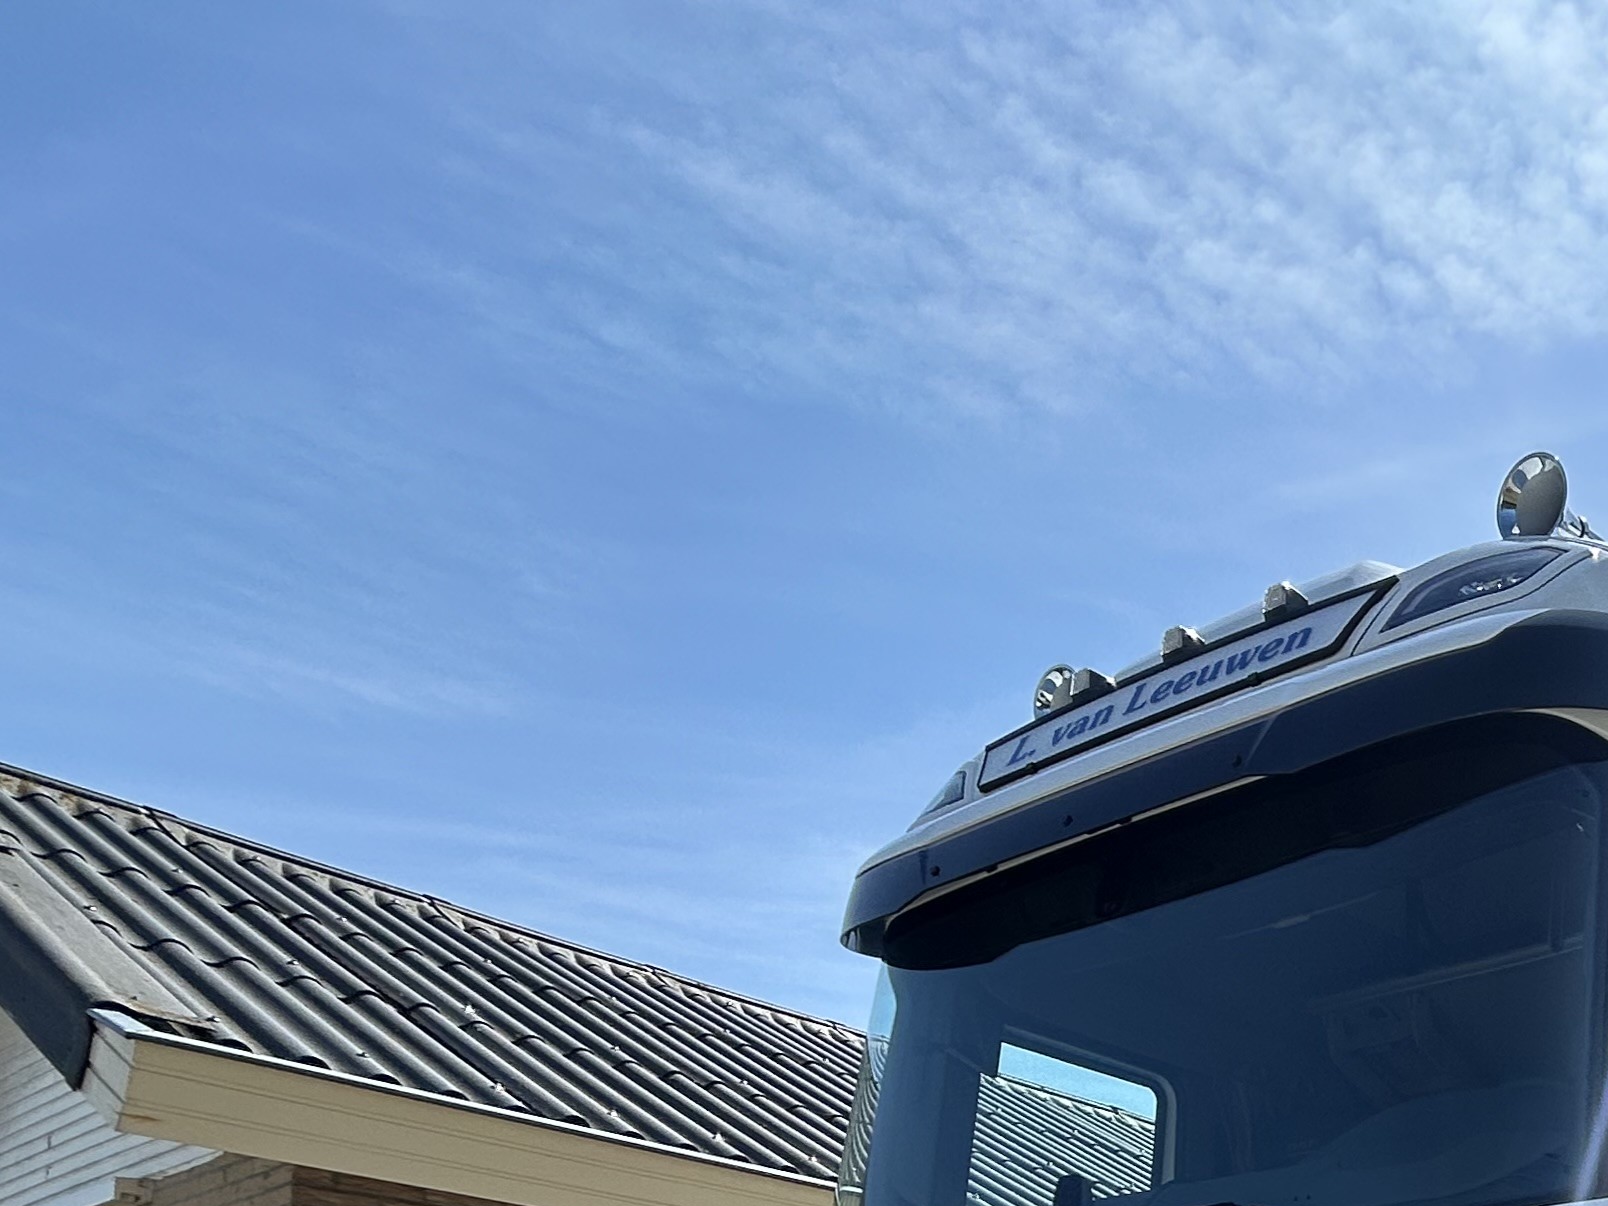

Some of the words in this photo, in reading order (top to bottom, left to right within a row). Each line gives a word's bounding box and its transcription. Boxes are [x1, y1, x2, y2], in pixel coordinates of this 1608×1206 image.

[1006, 735, 1036, 767] L.
[1051, 704, 1114, 749] van
[1121, 625, 1314, 717] Leeuwen
